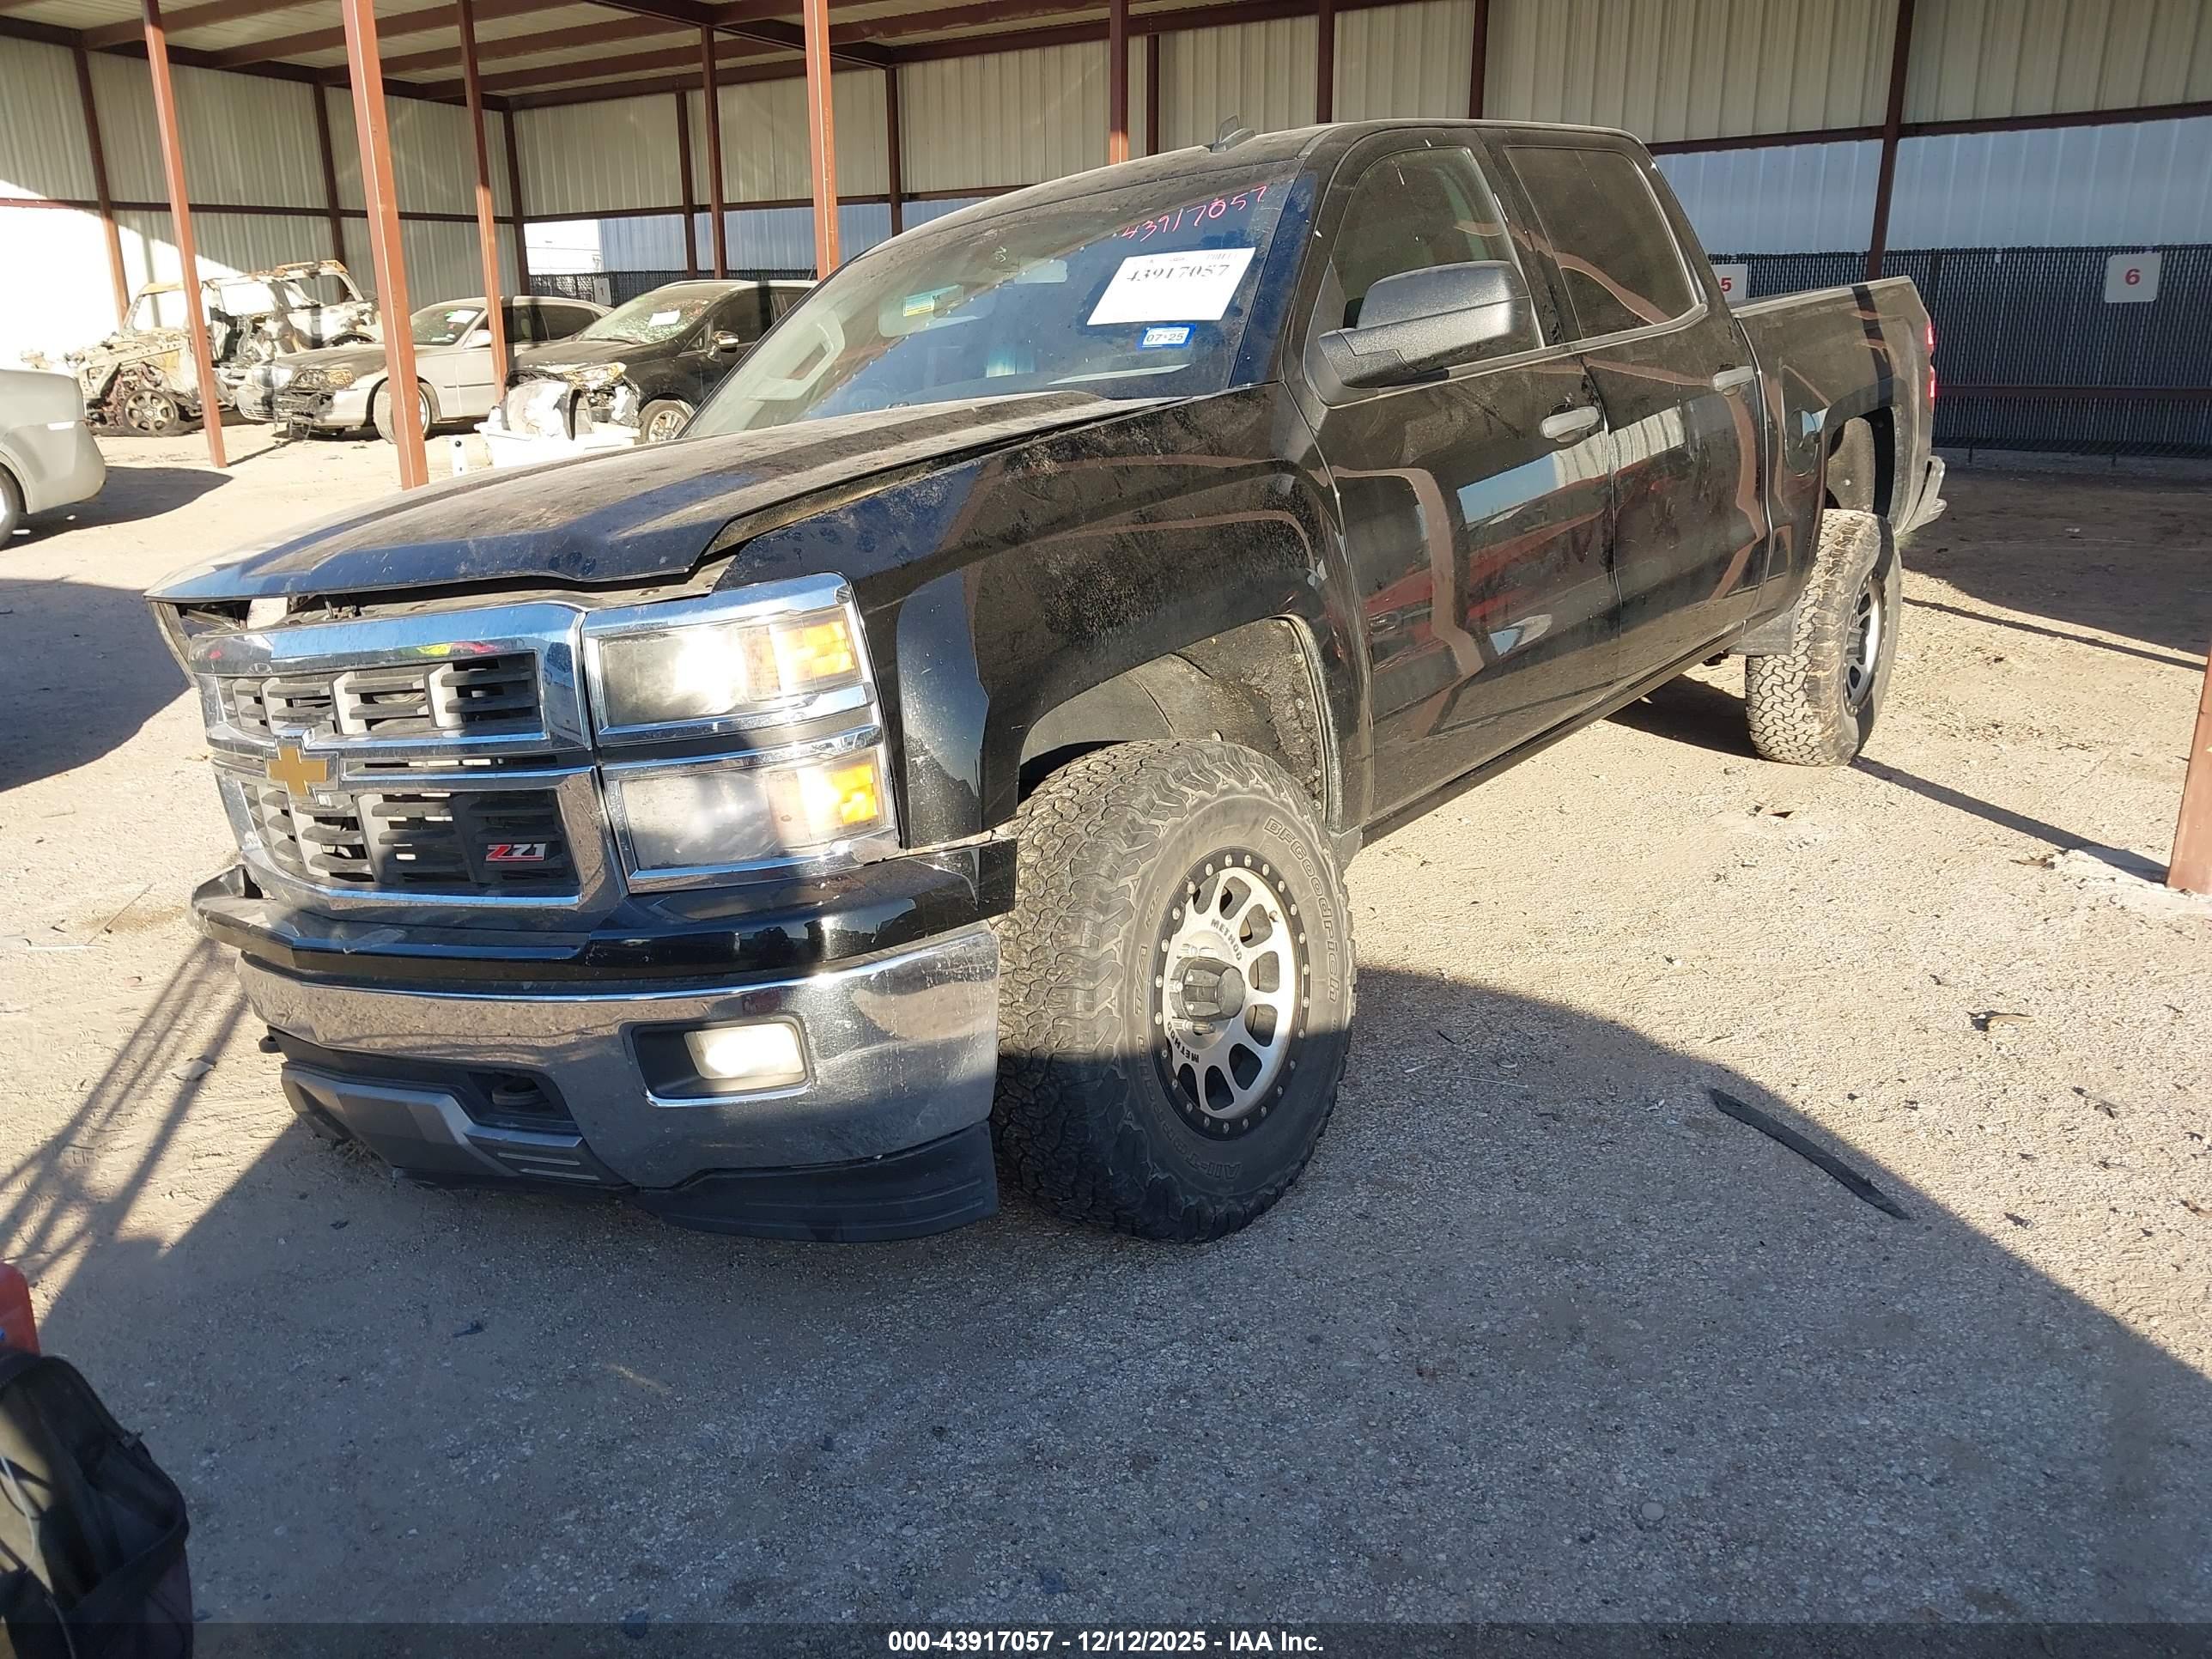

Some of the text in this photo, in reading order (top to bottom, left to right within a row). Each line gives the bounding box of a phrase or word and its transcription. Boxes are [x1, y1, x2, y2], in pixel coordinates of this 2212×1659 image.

[1121, 185, 1267, 242] 43917057
[1127, 264, 1230, 282] 43917057
[1721, 276, 1732, 292] 5
[2125, 269, 2141, 285] 6
[485, 843, 547, 861] Z71
[1263, 817, 1340, 1003] BFGoodrich
[1211, 918, 1243, 961] METHOD
[1167, 1021, 1200, 1064] METHOD
